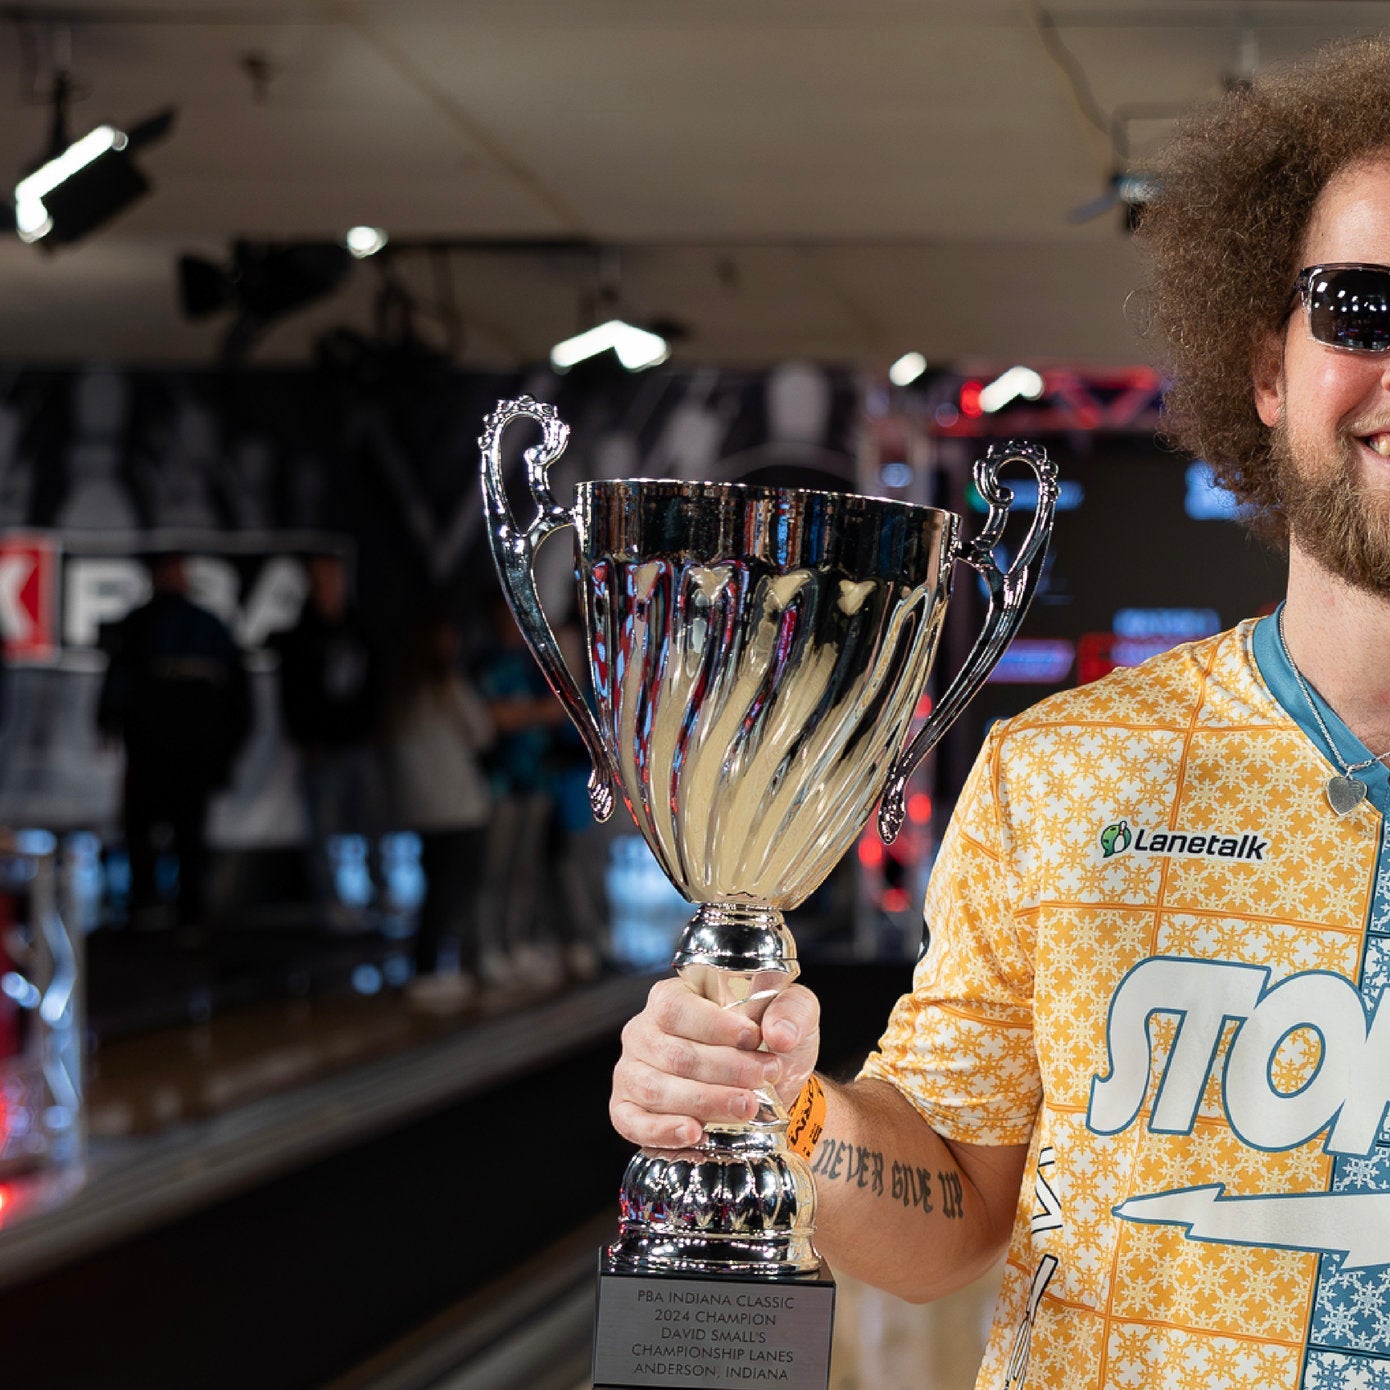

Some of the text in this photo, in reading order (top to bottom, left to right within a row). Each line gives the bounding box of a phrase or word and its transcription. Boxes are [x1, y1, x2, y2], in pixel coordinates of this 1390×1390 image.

[1134, 829, 1267, 860] Lanetalk
[637, 1289, 795, 1310] PBA INDIANA CLASSIC
[655, 1309, 777, 1326] 2024 CHAMPION
[661, 1327, 767, 1344] DAVID SMALL'S
[631, 1343, 794, 1363] CHAMPIONSHIP LANES
[633, 1363, 788, 1380] ANDERSON, INDIANA
